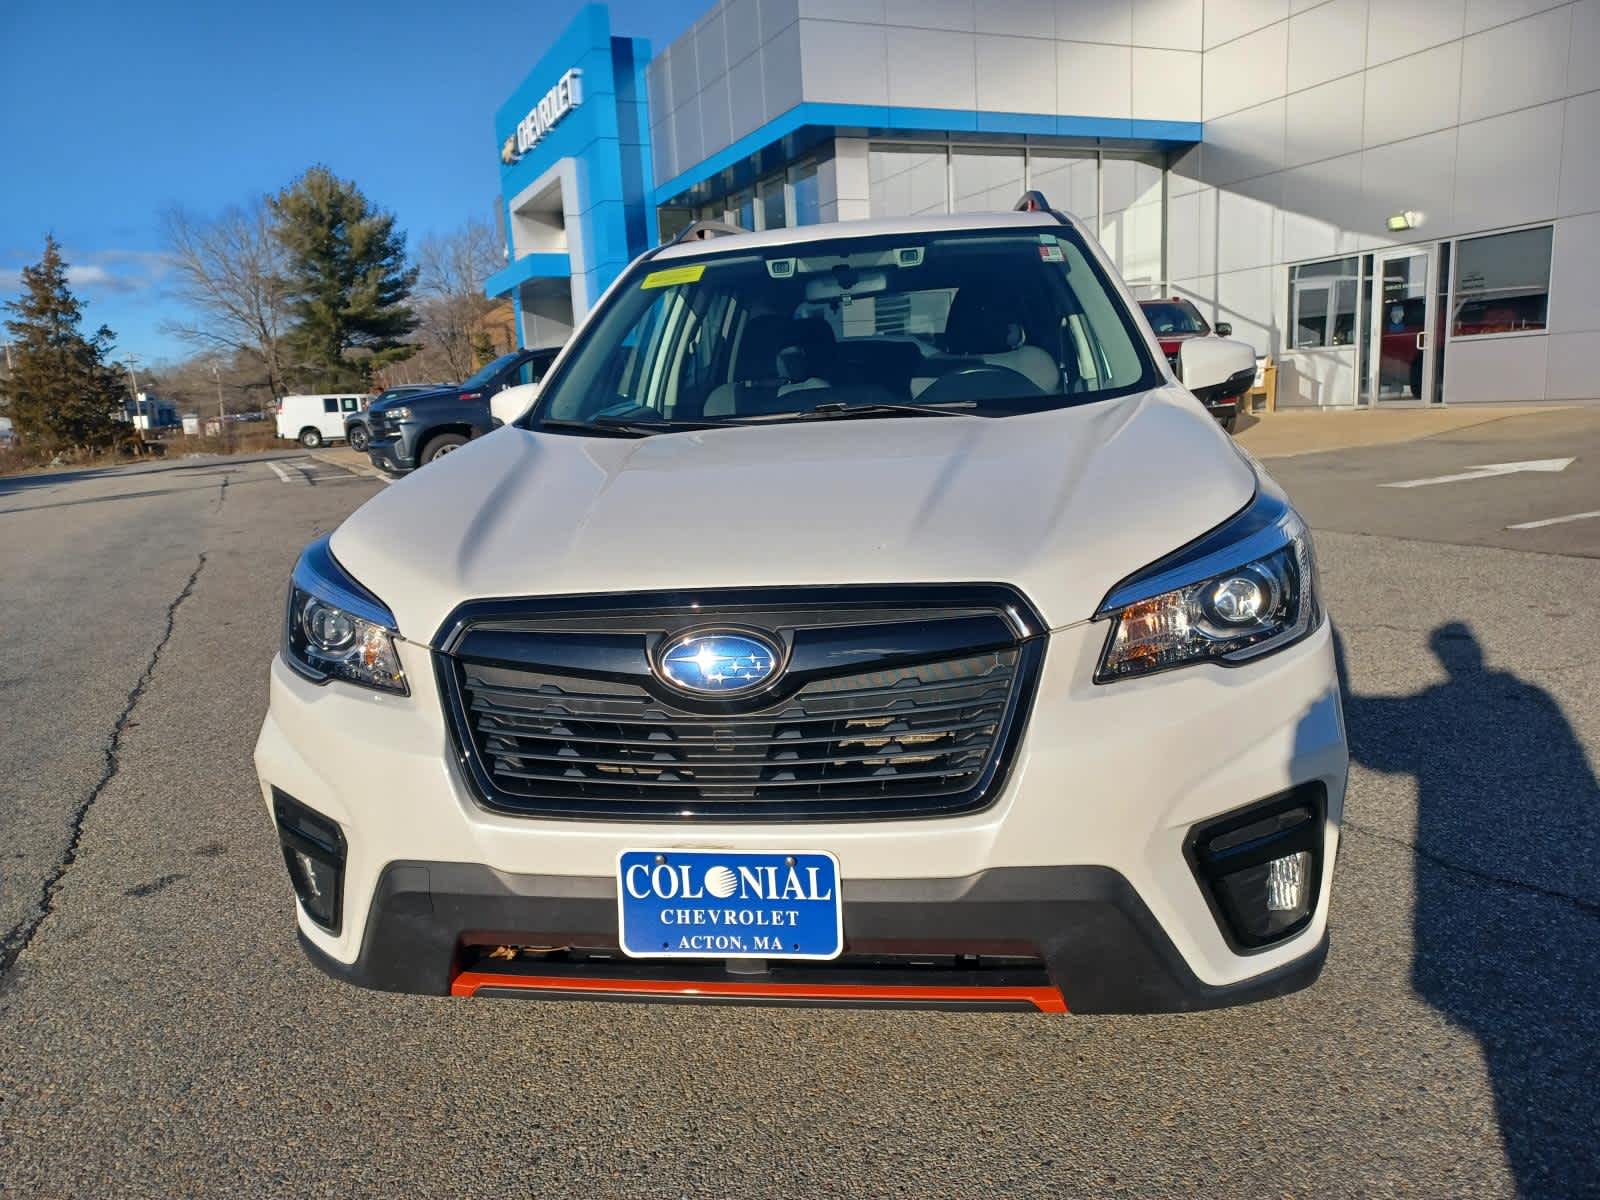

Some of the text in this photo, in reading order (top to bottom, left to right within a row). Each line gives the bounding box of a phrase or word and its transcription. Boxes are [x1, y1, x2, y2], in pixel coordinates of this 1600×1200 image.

[517, 68, 582, 154] CHEVROLET
[626, 864, 832, 901] COLONIAL
[660, 909, 799, 926] CHEVROLET
[679, 935, 783, 951] ACTON, MA
